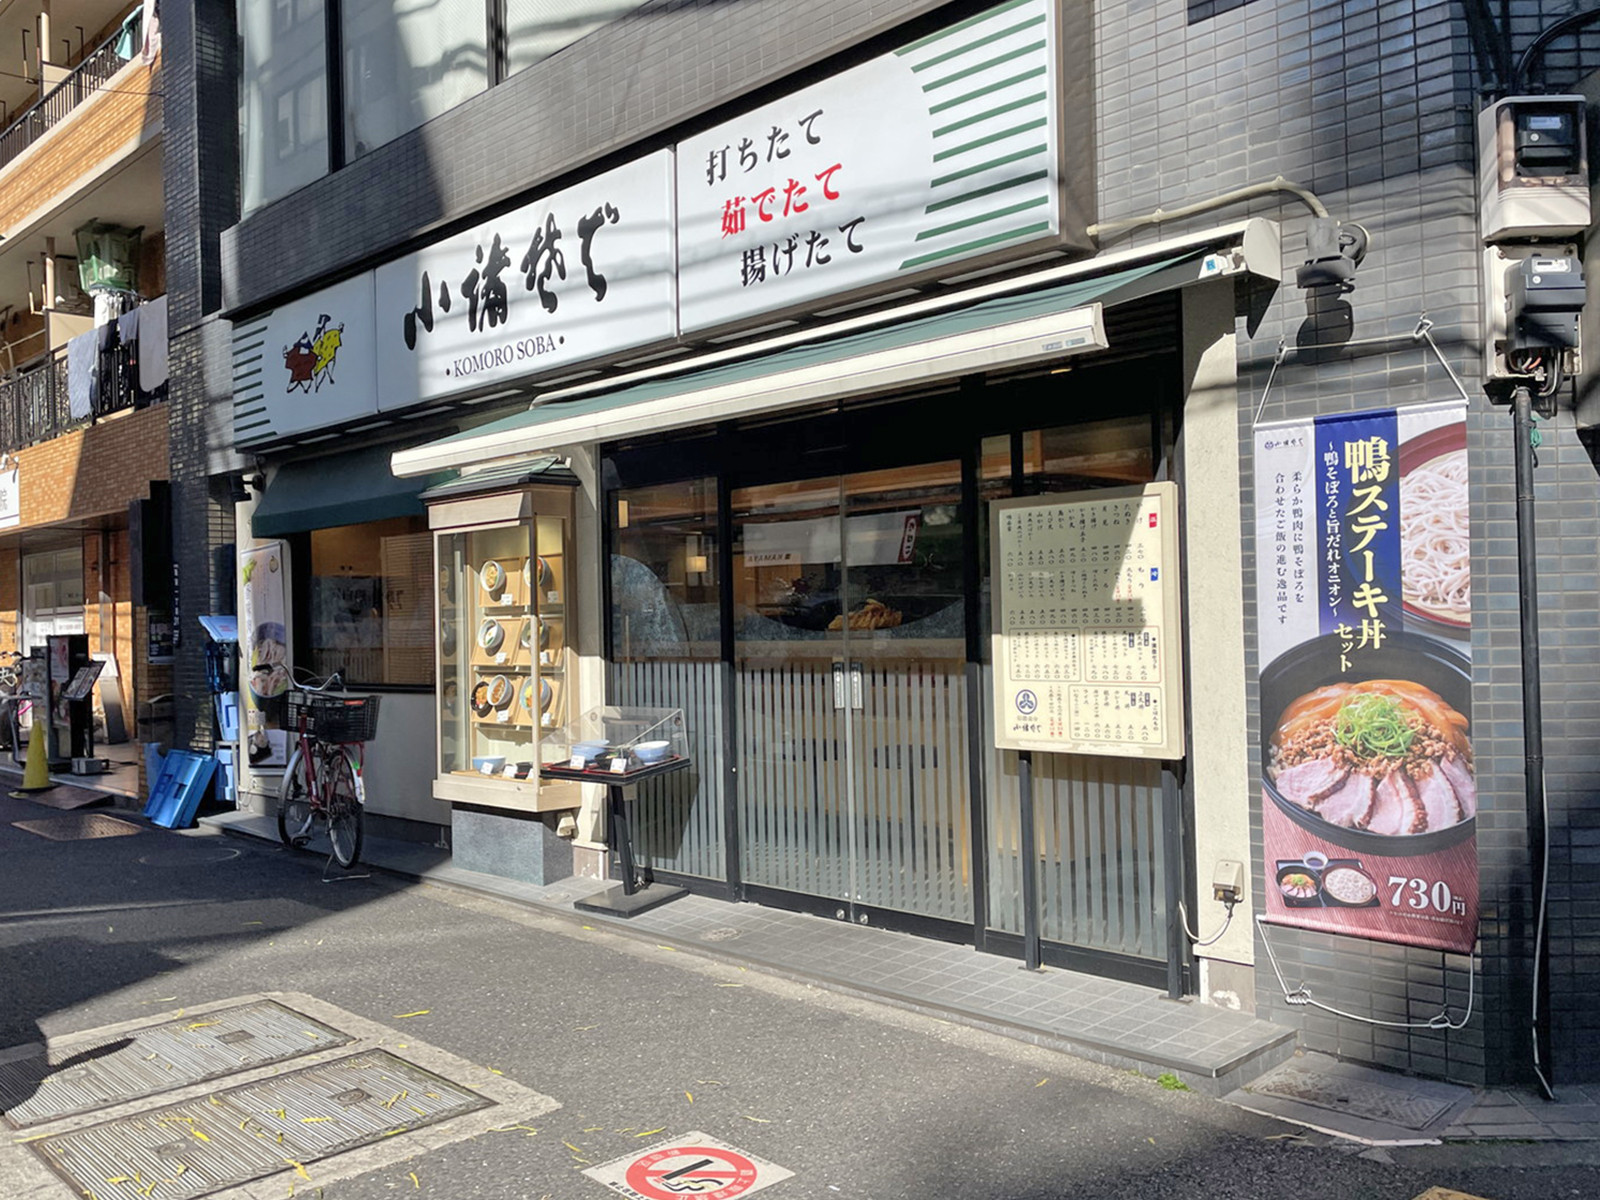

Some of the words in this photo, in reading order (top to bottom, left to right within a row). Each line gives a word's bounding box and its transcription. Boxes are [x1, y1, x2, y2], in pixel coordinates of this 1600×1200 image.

[706, 108, 824, 186] 打ちたて
[720, 163, 843, 240] 茹でたて
[740, 216, 866, 287] 揚げたて
[453, 342, 514, 378] KOMORO
[516, 333, 556, 361] SOBA
[1275, 473, 1288, 625] 合わせたご飯の進む逸品です
[1292, 471, 1304, 604] 柔らか鴨肉に鴨そぼろを
[1344, 436, 1392, 650] 鴨ステーキ丼
[1333, 622, 1353, 673] セット
